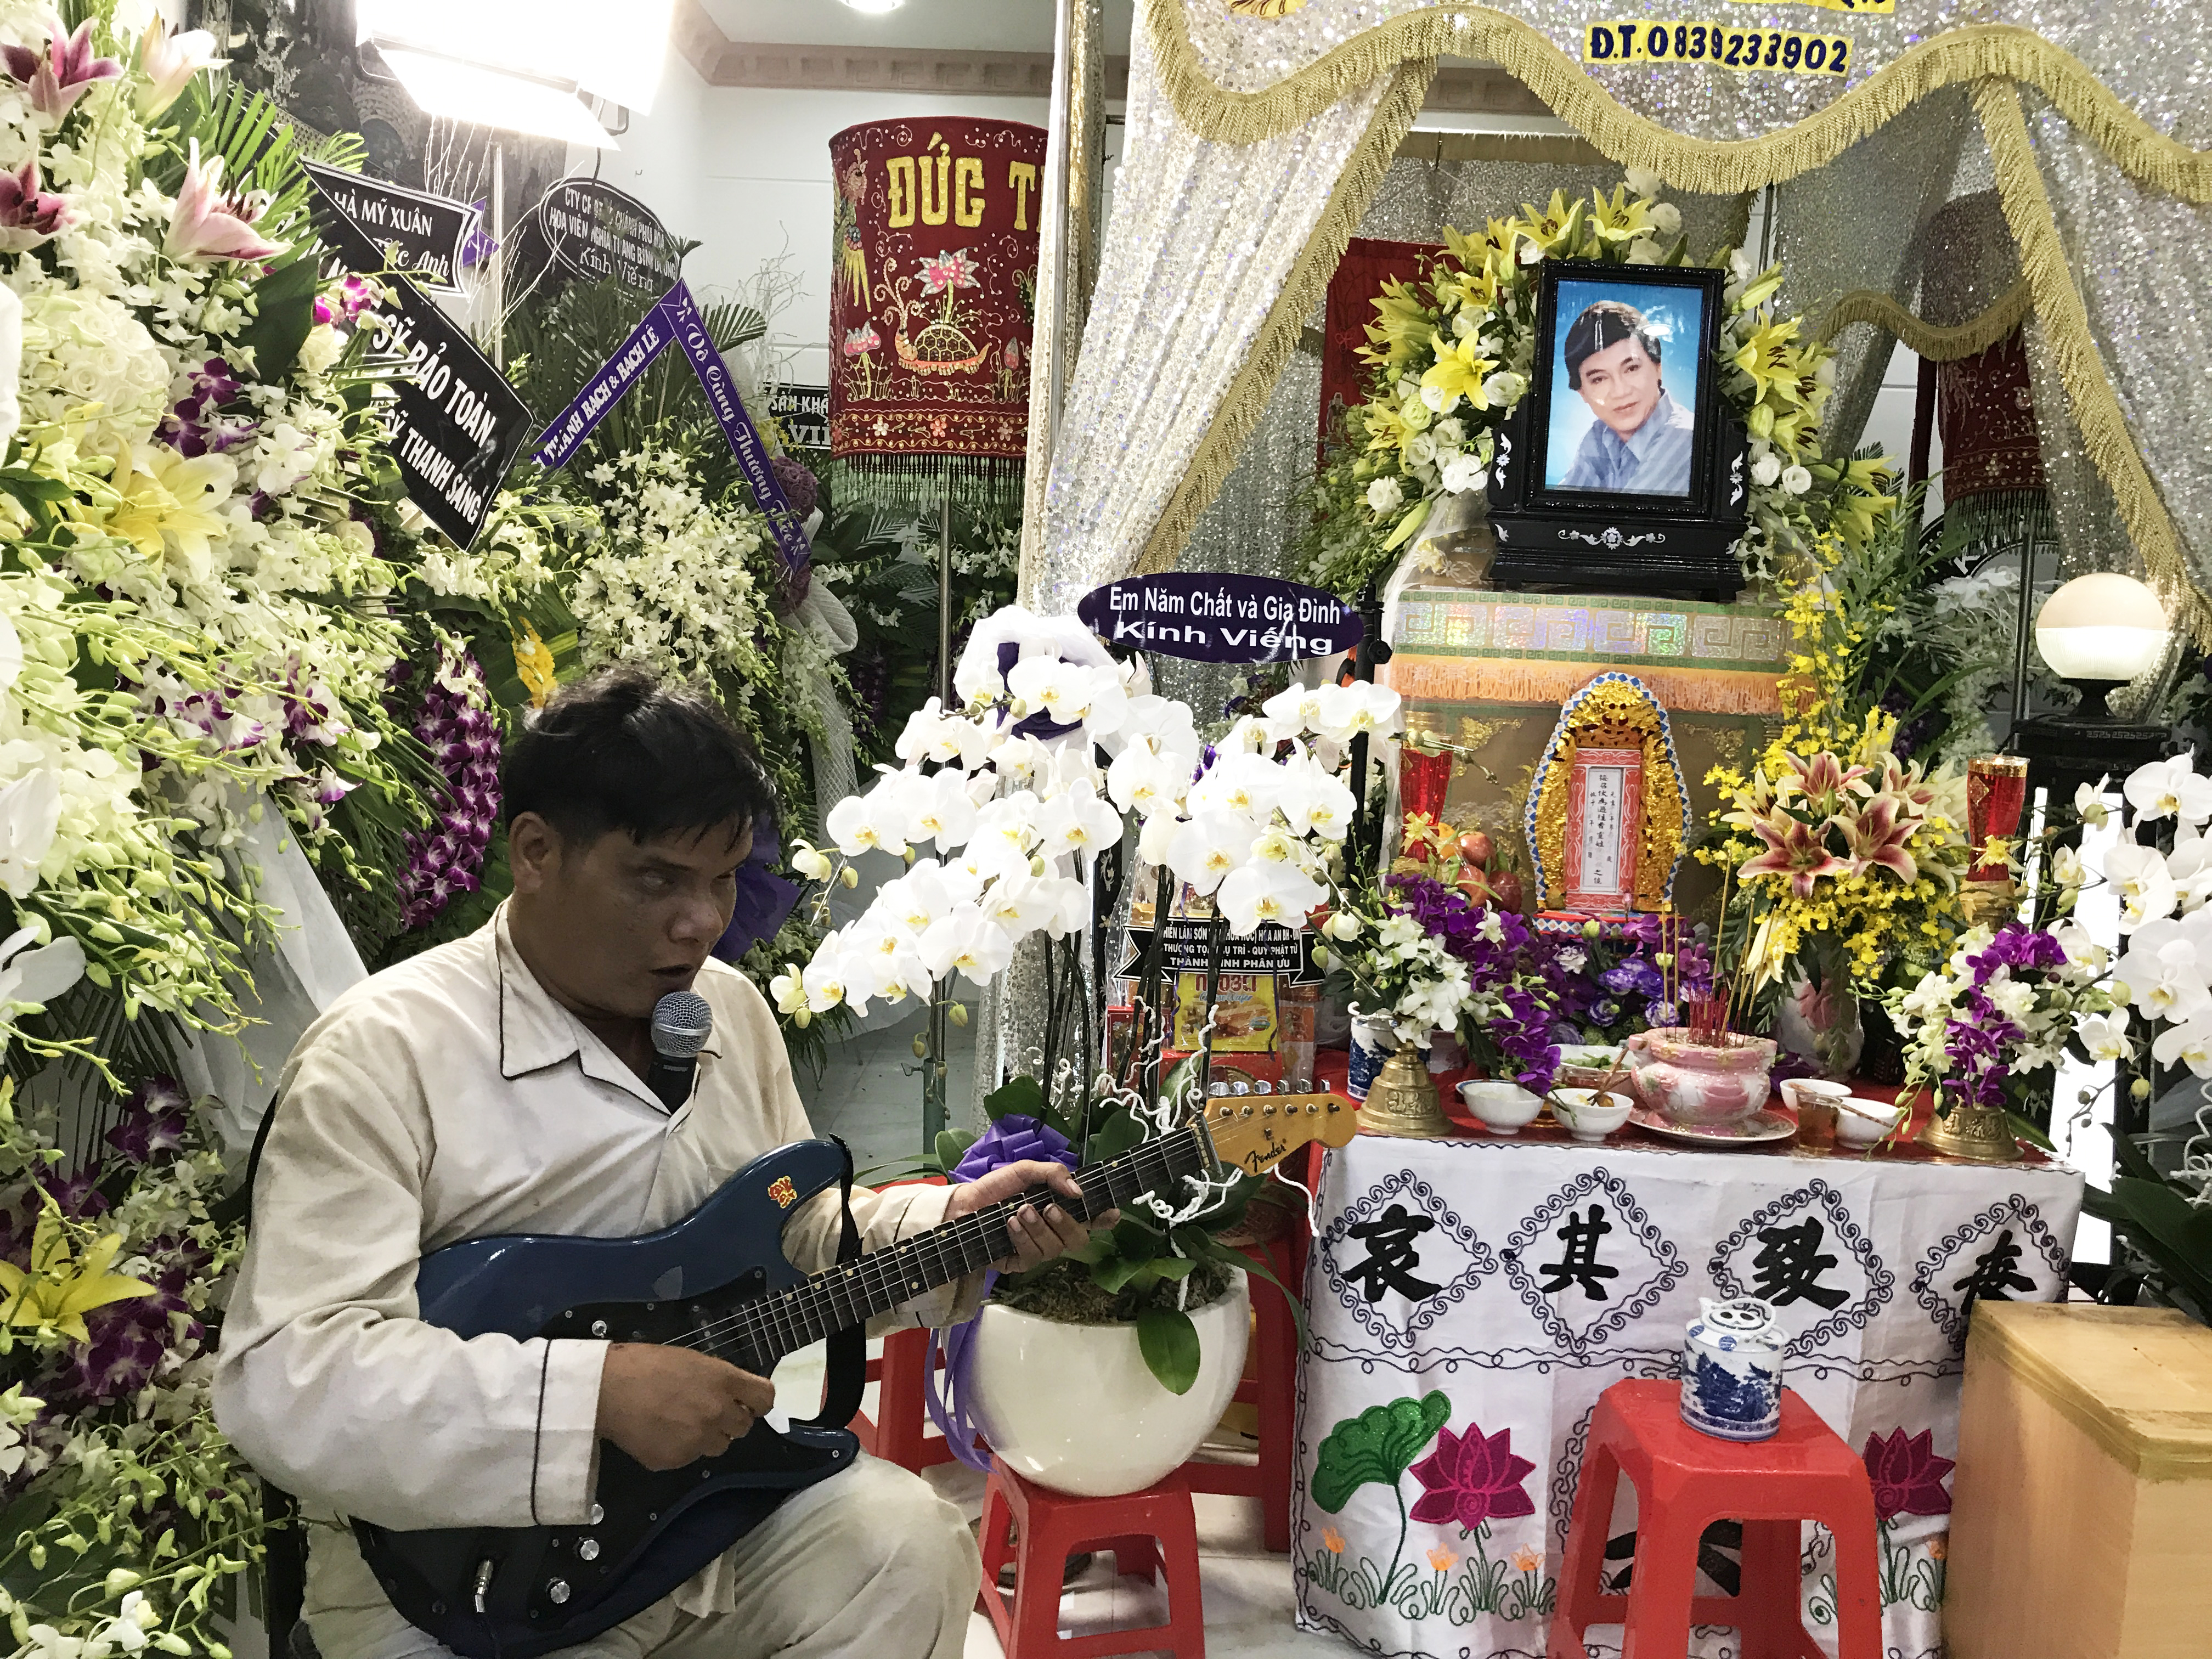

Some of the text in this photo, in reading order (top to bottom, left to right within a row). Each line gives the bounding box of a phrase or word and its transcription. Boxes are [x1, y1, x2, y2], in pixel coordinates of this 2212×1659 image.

[886, 132, 985, 228] ĐỨC
[361, 198, 387, 225] MỸ
[390, 207, 432, 237] XUÂN
[549, 206, 567, 232] HOA
[568, 213, 588, 239] VIÊN
[565, 187, 580, 210] CTY
[638, 221, 652, 244] PHÚ
[412, 250, 450, 277] Anh
[579, 247, 653, 294] Kính Viếng
[580, 380, 612, 421] BẠCH
[608, 375, 620, 389] &
[616, 341, 646, 382] BẠCH
[641, 324, 659, 353] LÊ
[399, 340, 451, 400] BẢO
[444, 377, 496, 449] TOÀN
[706, 365, 735, 424] Cùng
[733, 421, 772, 502] Thương
[400, 426, 456, 492] THANH
[1109, 586, 1340, 624] Em Năm Chất và Gia Đình
[1115, 620, 1333, 656] Kính Viếng
[1193, 926, 1207, 940] SƠN
[1273, 929, 1282, 941] AN
[1197, 945, 1209, 956] TỌ
[1232, 944, 1246, 955] TRÌ
[1270, 944, 1289, 957] PHẬT
[1289, 943, 1298, 955] TỬ
[1170, 956, 1209, 967] THÀNH
[1243, 957, 1274, 968] PHÂN
[1277, 957, 1290, 968] ƯU
[1244, 1142, 1287, 1173] Fender
[1539, 1204, 1619, 1301] 其
